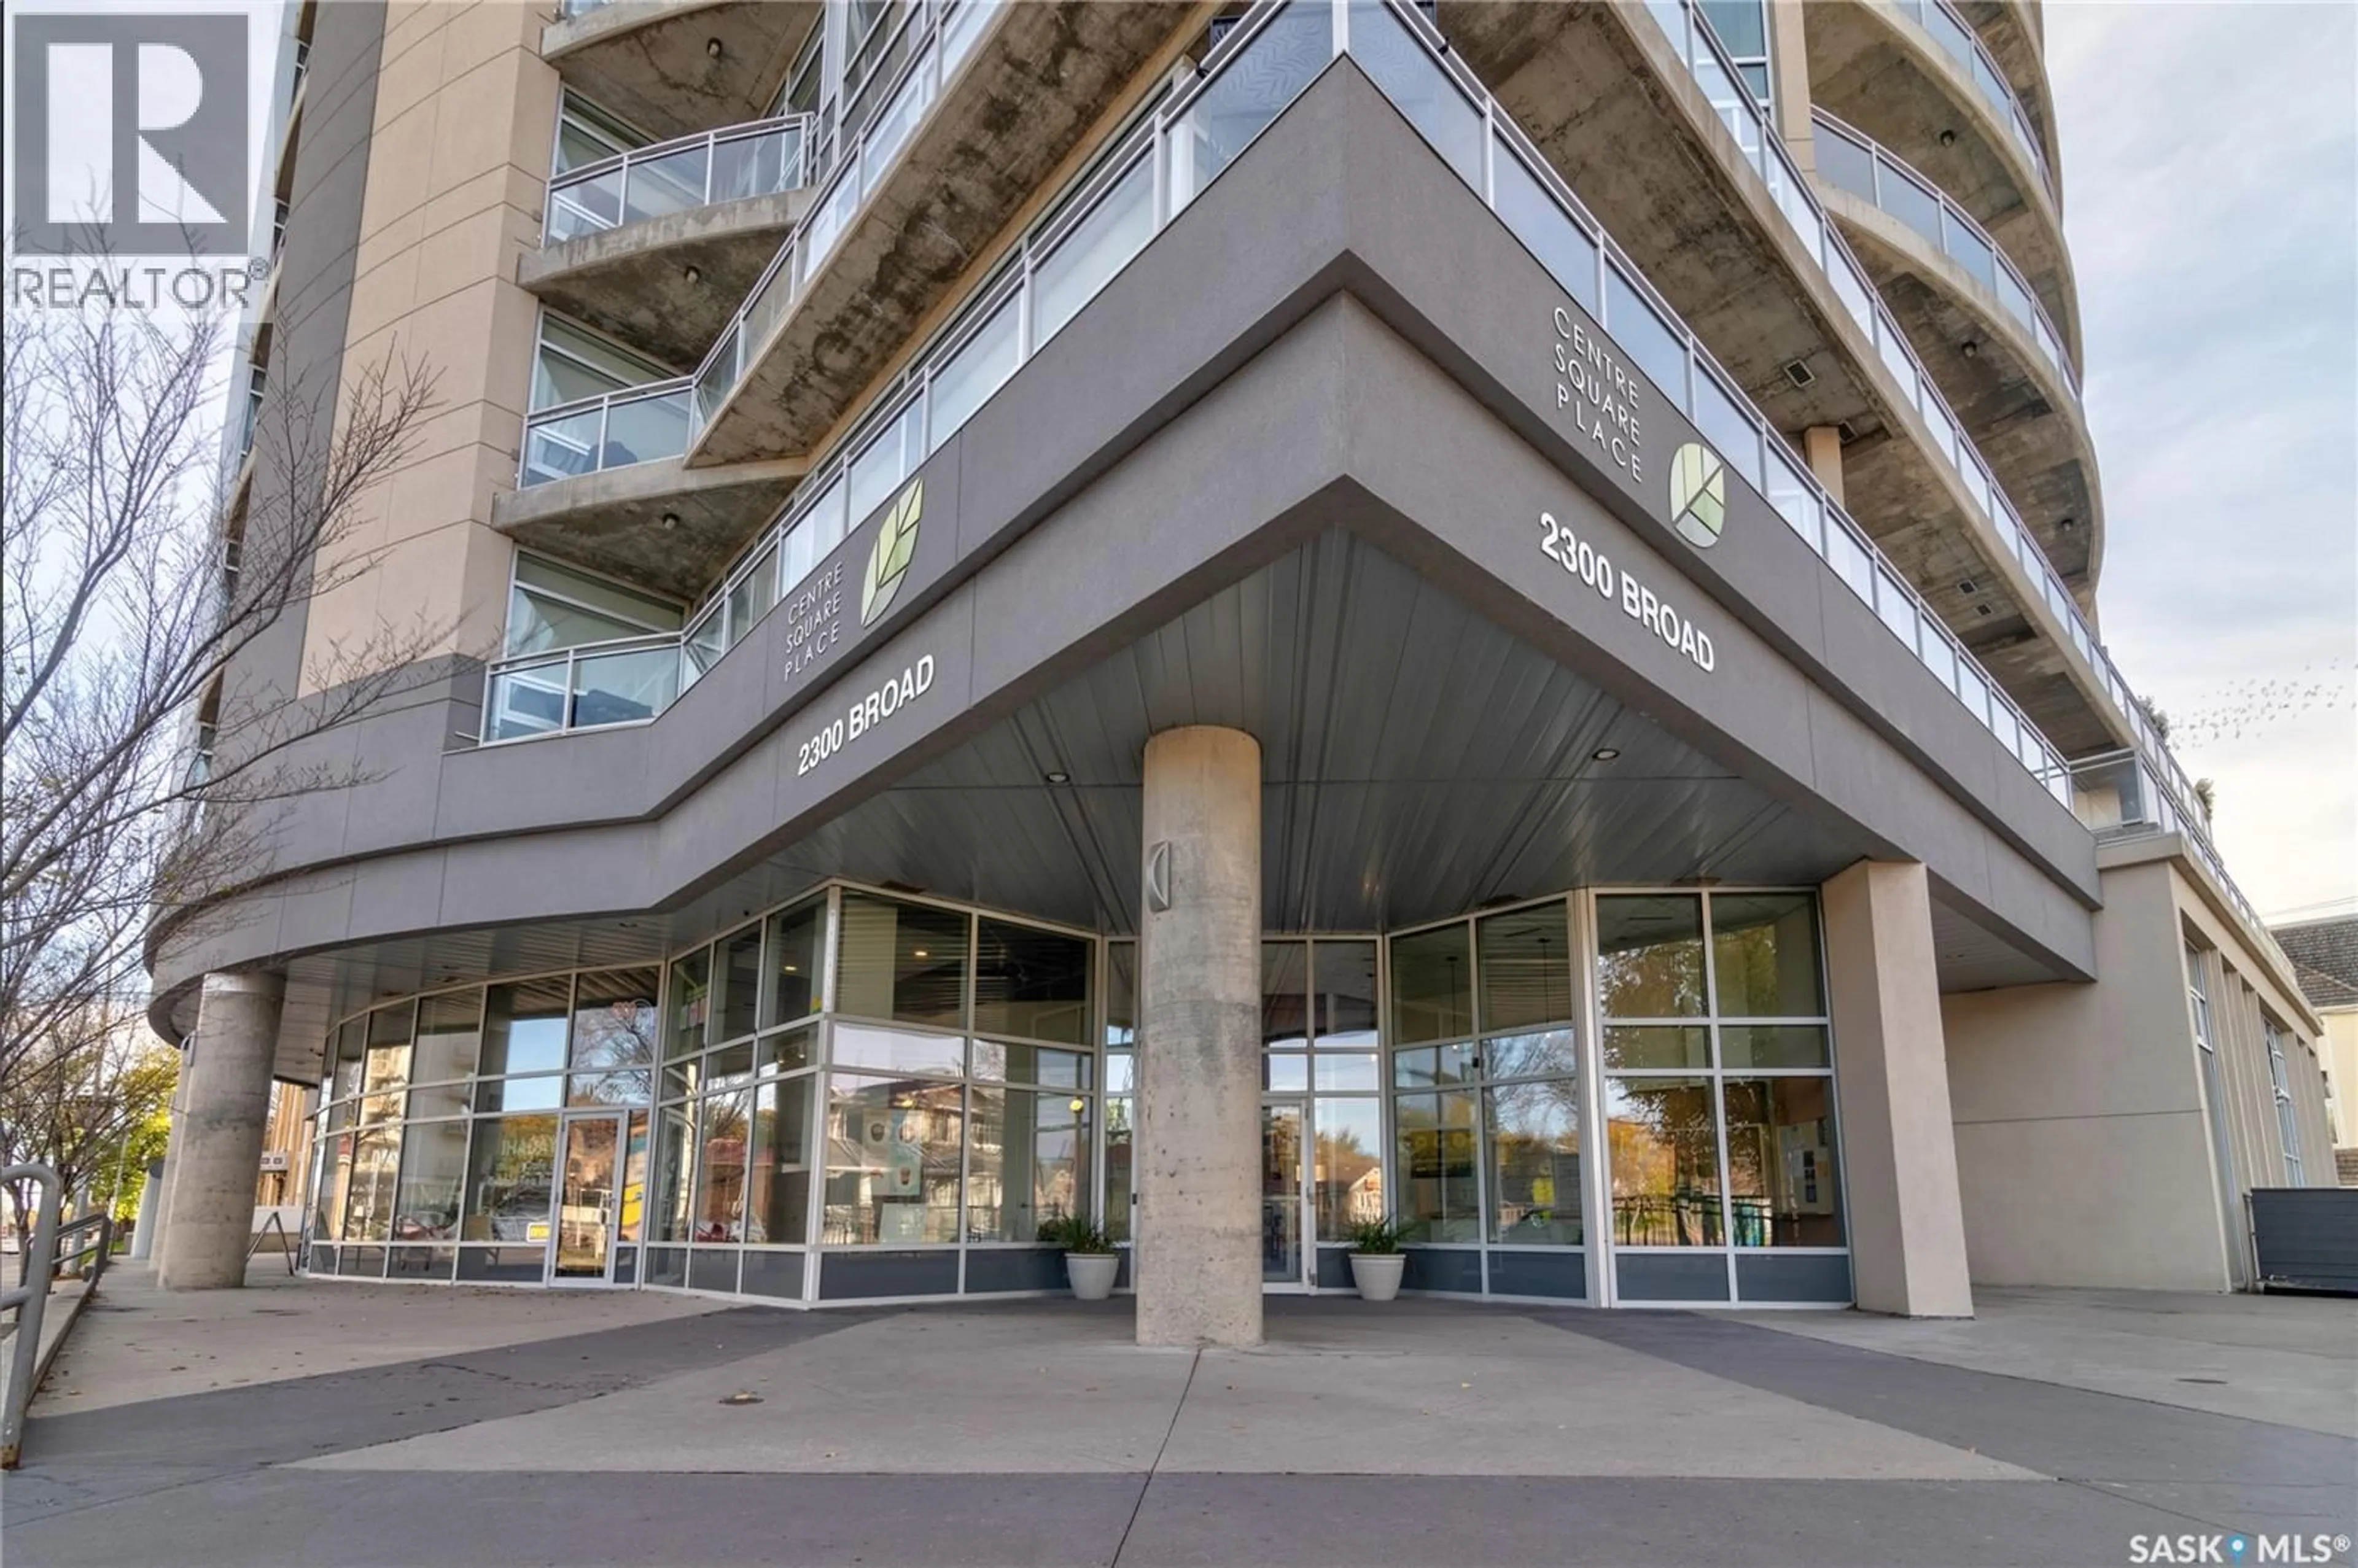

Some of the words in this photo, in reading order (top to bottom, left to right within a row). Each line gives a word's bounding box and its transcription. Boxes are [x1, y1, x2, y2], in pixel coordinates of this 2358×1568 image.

[1554, 307, 1639, 410] CENTRE
[1555, 344, 1641, 448] SQUARE
[1557, 383, 1643, 483] PLACE
[786, 591, 841, 654] SQUARE
[788, 561, 844, 625] CENTRE
[1539, 511, 1614, 600] 2300
[1621, 570, 1715, 673] BROAD
[784, 620, 839, 682] PLACE
[798, 718, 844, 777] 2300
[848, 654, 935, 742] BROAD
